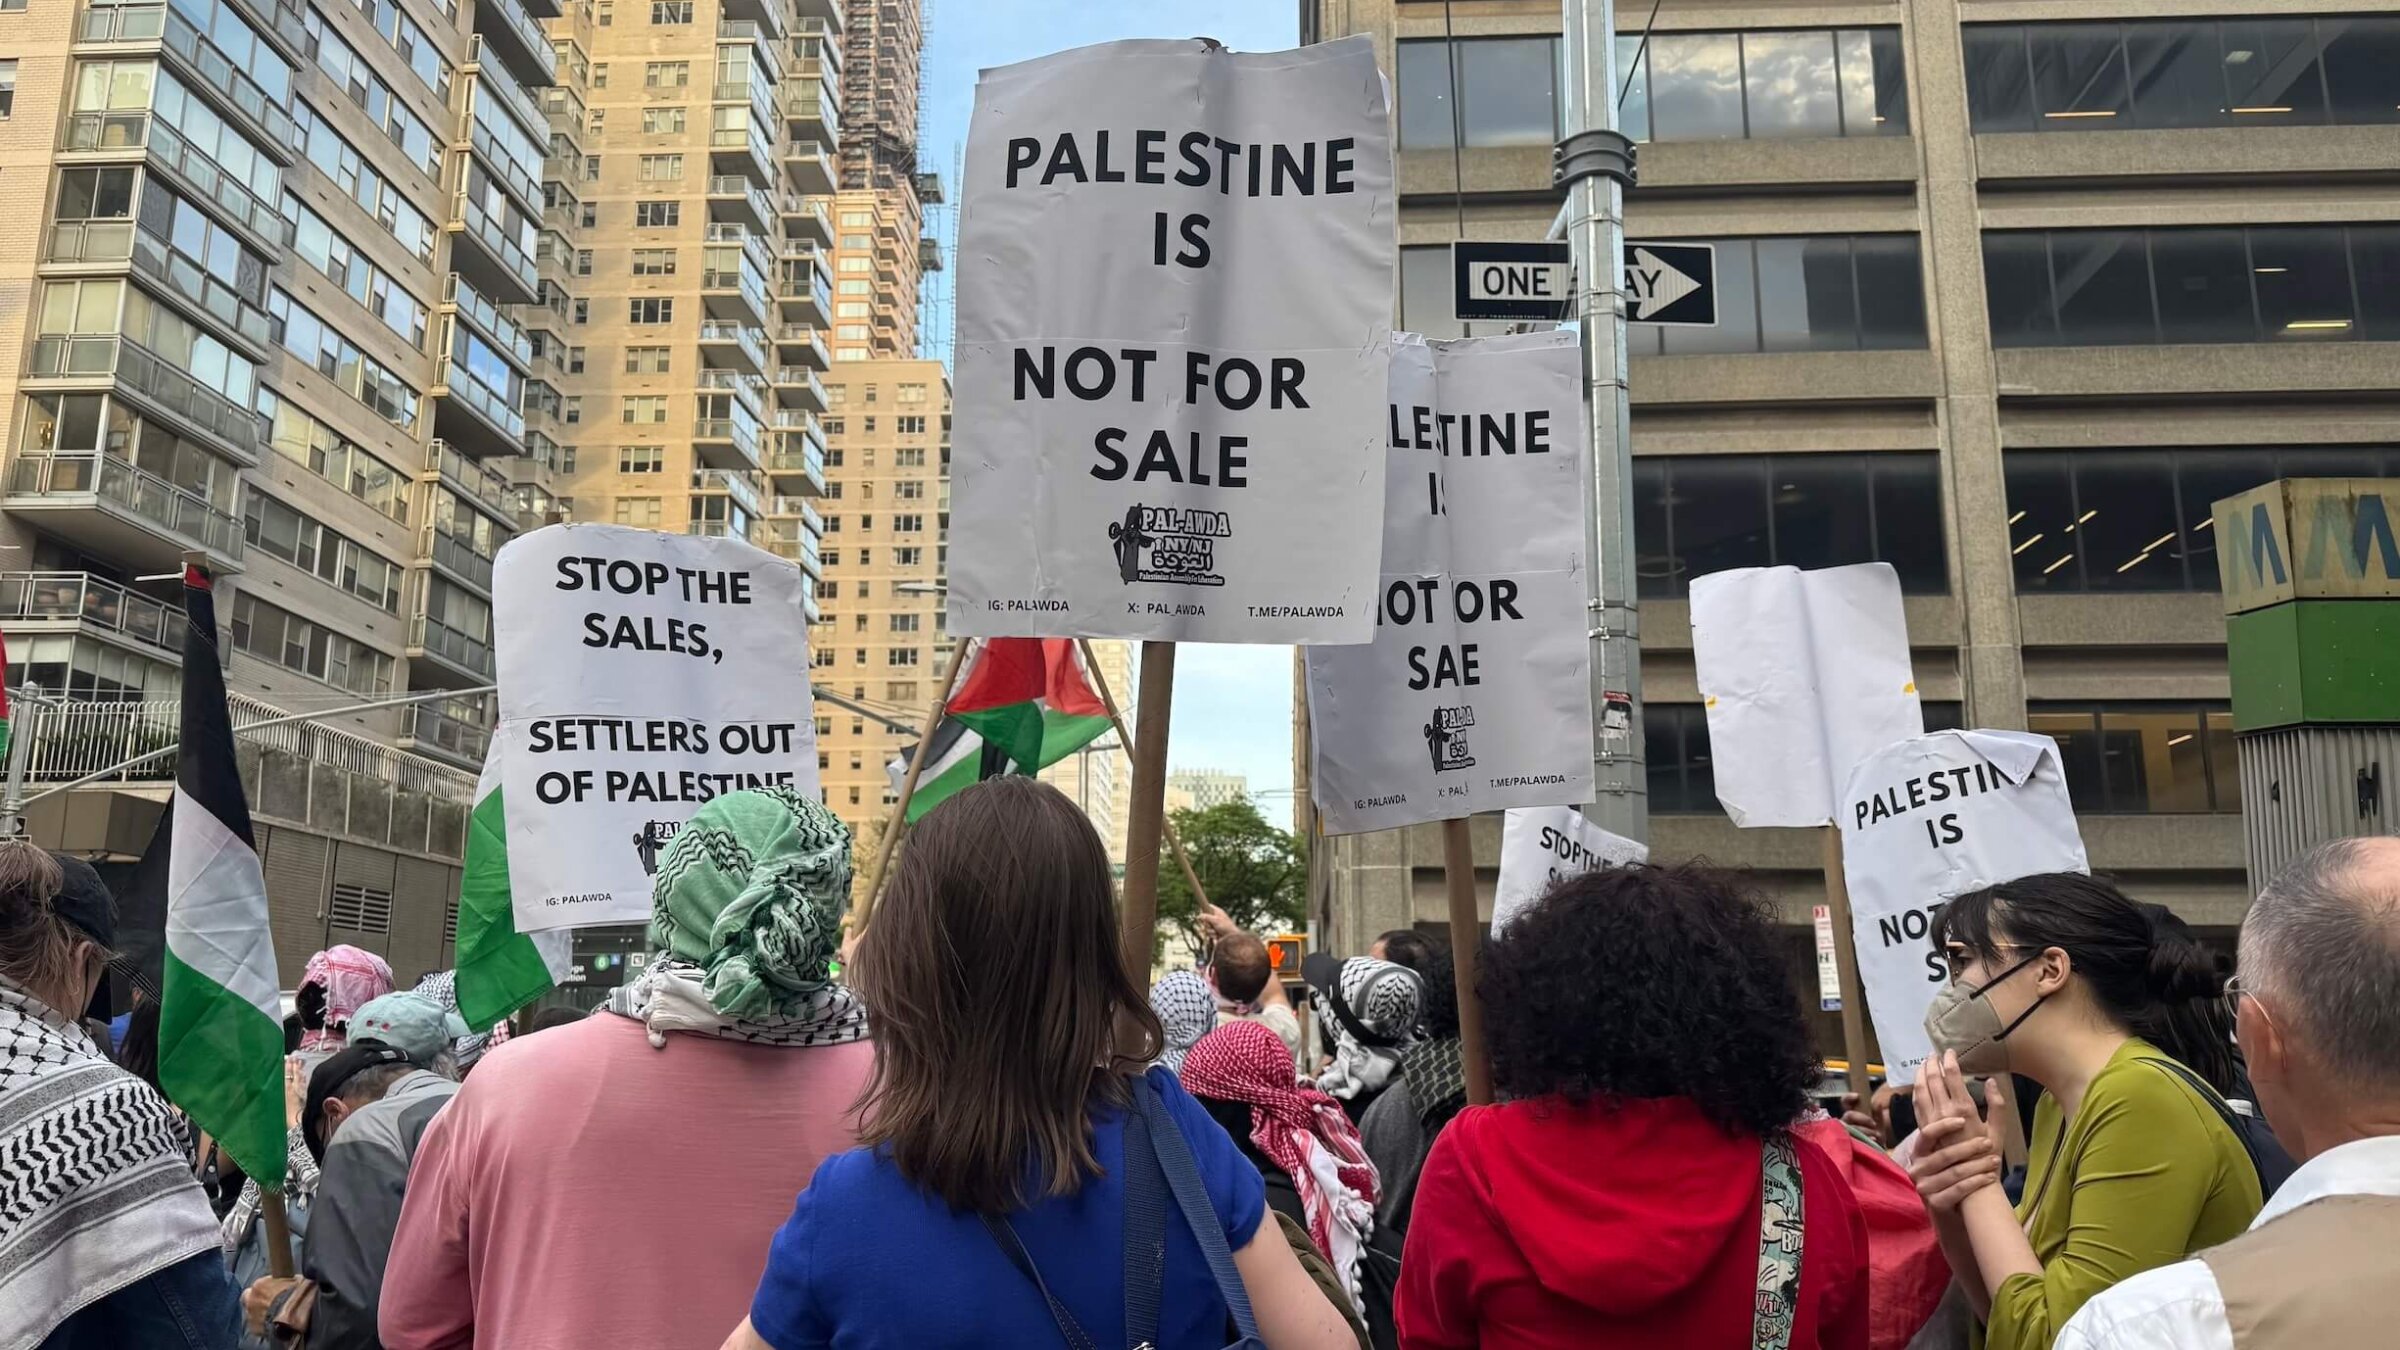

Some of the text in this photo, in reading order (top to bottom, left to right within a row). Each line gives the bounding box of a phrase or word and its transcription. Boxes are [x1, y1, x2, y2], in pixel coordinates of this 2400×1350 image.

[1006, 130, 1354, 197] PALESTINE
[1154, 212, 1211, 268] IS
[1483, 266, 1662, 298] ONE AY
[1013, 346, 1311, 411] NOT FOR
[1090, 427, 1248, 488] SALE
[1429, 472, 1447, 517] I
[1141, 508, 1230, 536] PAL-AWDA
[1164, 536, 1212, 554] NY/NJ
[556, 556, 751, 604] STOP THE
[988, 599, 1069, 612] IG: PALAWDA
[1127, 603, 1206, 616] X: PAL_AWDA
[1247, 605, 1344, 618] T.ME/PALAWDA
[1377, 579, 1524, 626] OT OR
[583, 612, 723, 664] SALES,
[528, 719, 795, 755] SETTLERS OUT
[535, 770, 593, 804] OF
[1490, 774, 1565, 788] T.ME/PALAWDA
[1856, 760, 2036, 830] PALESTIN
[1367, 794, 1407, 808] PALAWDA
[1540, 826, 1581, 863] STOP
[1925, 813, 1963, 849] IS
[546, 893, 612, 907] IG: PALAWDA
